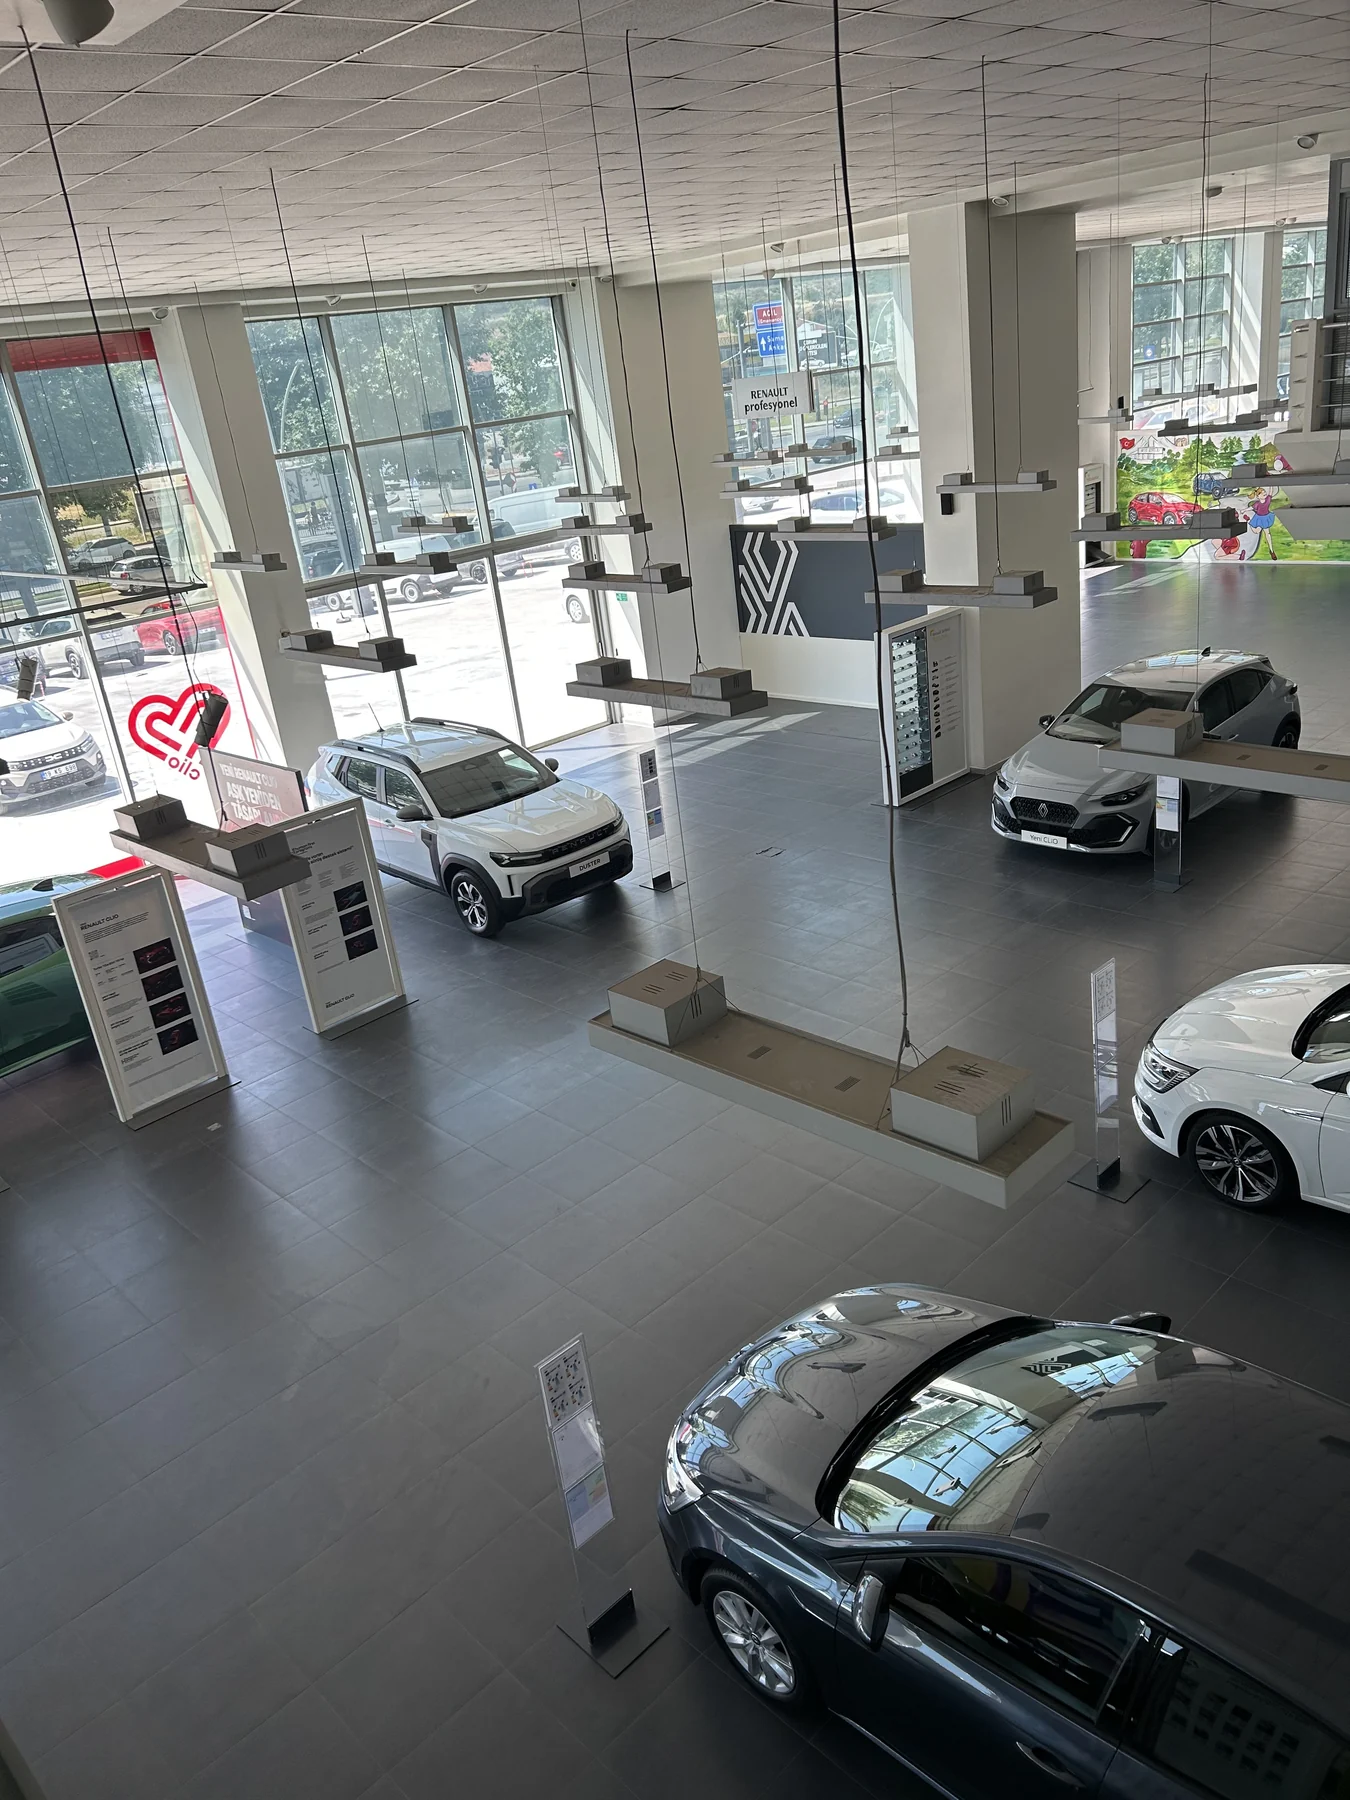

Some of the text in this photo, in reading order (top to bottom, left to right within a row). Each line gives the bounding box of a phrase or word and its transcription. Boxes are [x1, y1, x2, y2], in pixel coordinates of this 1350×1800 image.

[750, 387, 788, 399] RENAULT
[744, 396, 798, 415] profesyonel
[1029, 834, 1059, 845] Yeni CLIO
[579, 858, 601, 872] DUSTER
[80, 913, 119, 931] RENAULT CLIO
